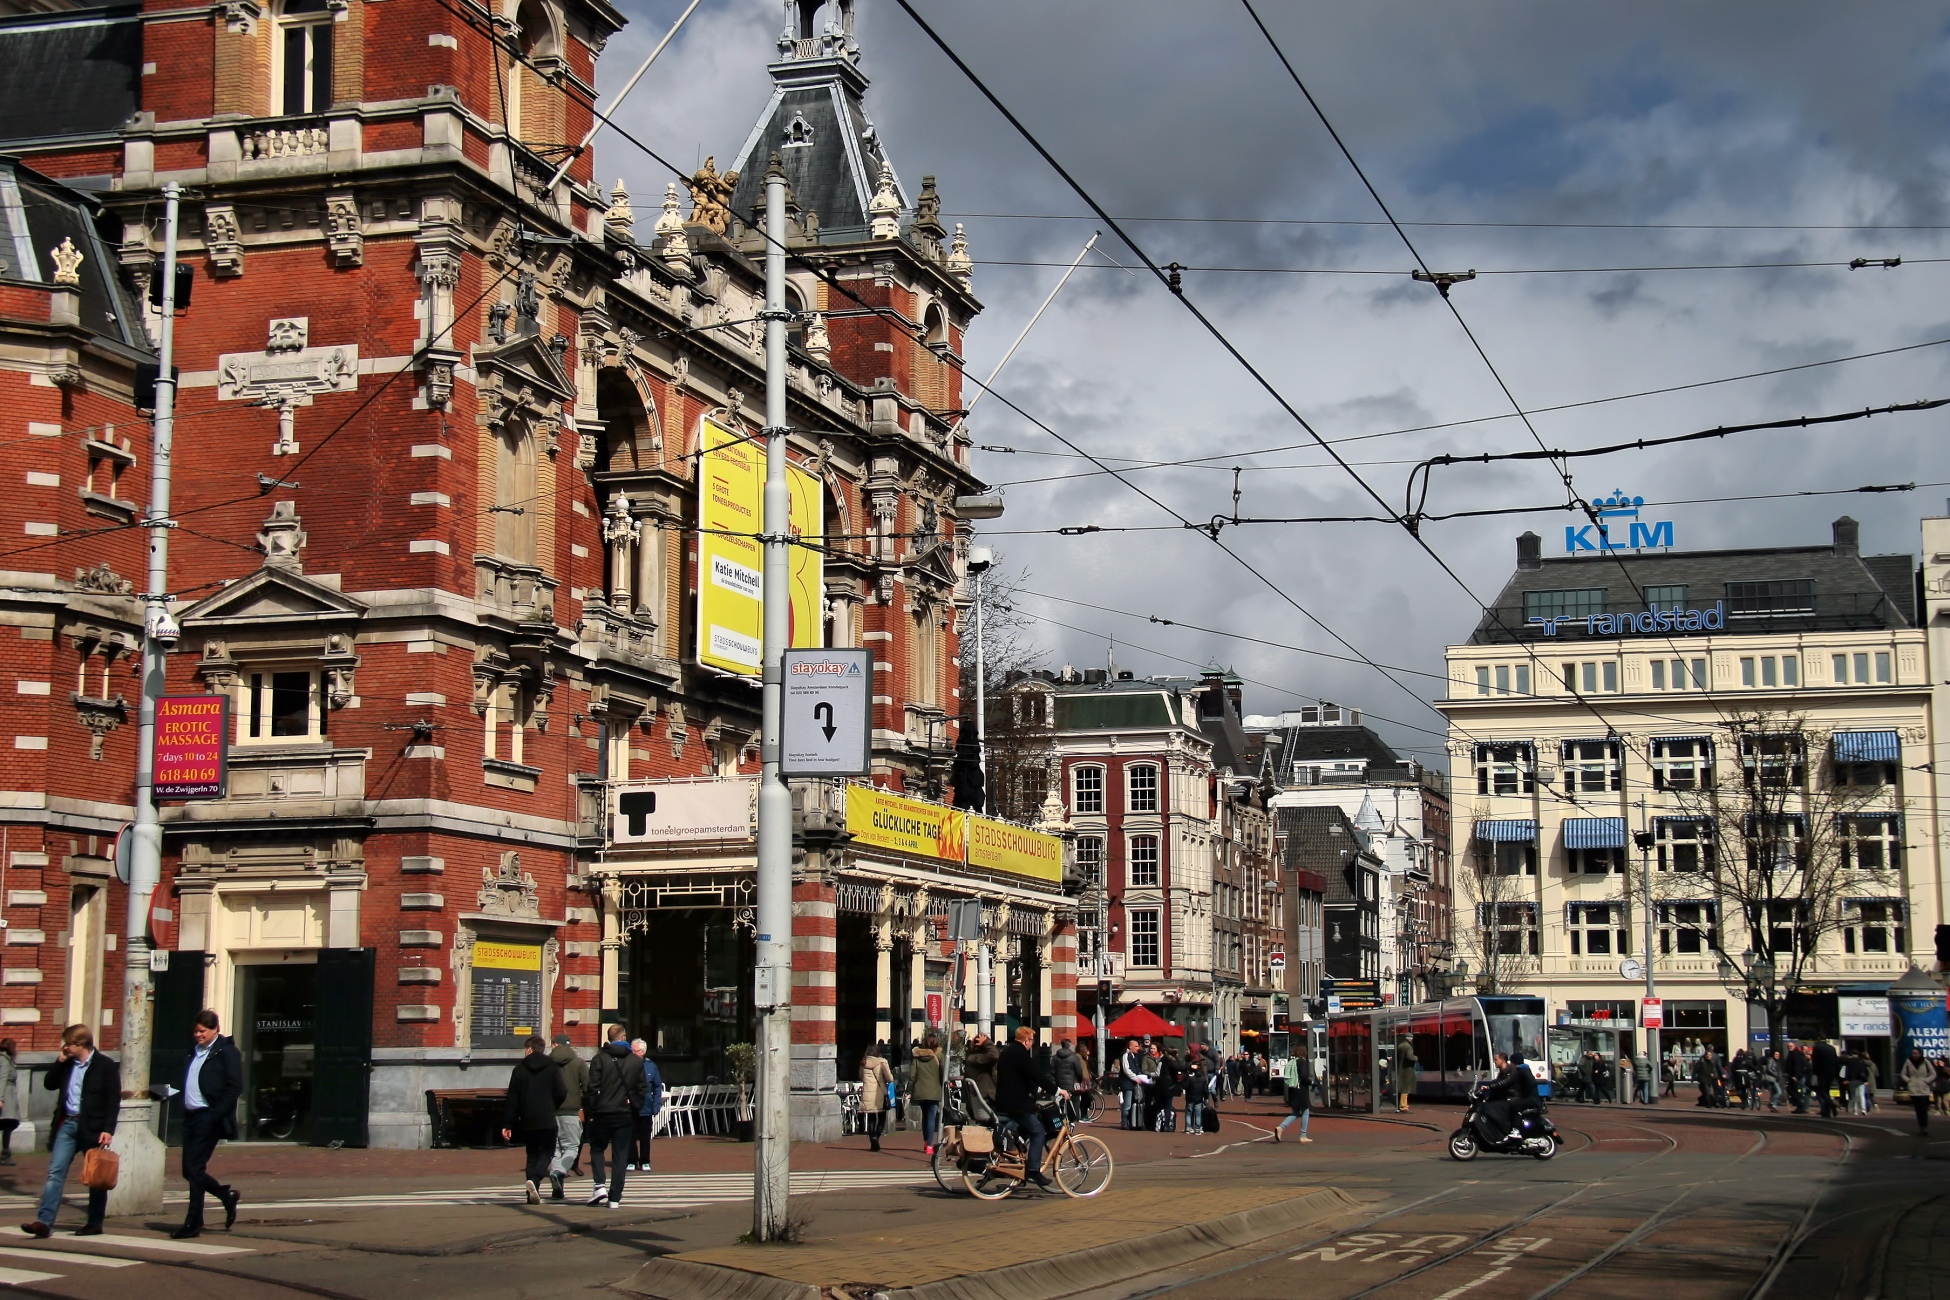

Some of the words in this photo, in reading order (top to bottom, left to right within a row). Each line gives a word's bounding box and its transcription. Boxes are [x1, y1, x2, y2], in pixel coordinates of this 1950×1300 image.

[715, 438, 748, 461] INTNATIONAAL
[712, 494, 752, 517] TONEELPRODUCTIES
[1564, 520, 1675, 552] KLM
[715, 561, 733, 578] Katie
[734, 568, 760, 588] Mitchell
[1587, 600, 1724, 635] randstad
[791, 659, 848, 678] stayokay
[159, 701, 220, 716] Asmara
[165, 721, 212, 733] EROTIC
[158, 733, 219, 746] MASSAGE
[157, 753, 162, 762] 7
[163, 752, 183, 763] days
[184, 752, 195, 760] 10
[206, 752, 218, 760] 24
[160, 769, 180, 781] 618
[182, 769, 198, 780] 40
[200, 768, 216, 780] 69
[651, 824, 746, 836] toneelgroepamsterdam
[873, 809, 921, 836] GLÜCKLICHE
[923, 822, 942, 840] TAGE
[1337, 1233, 1552, 1251] BUS
